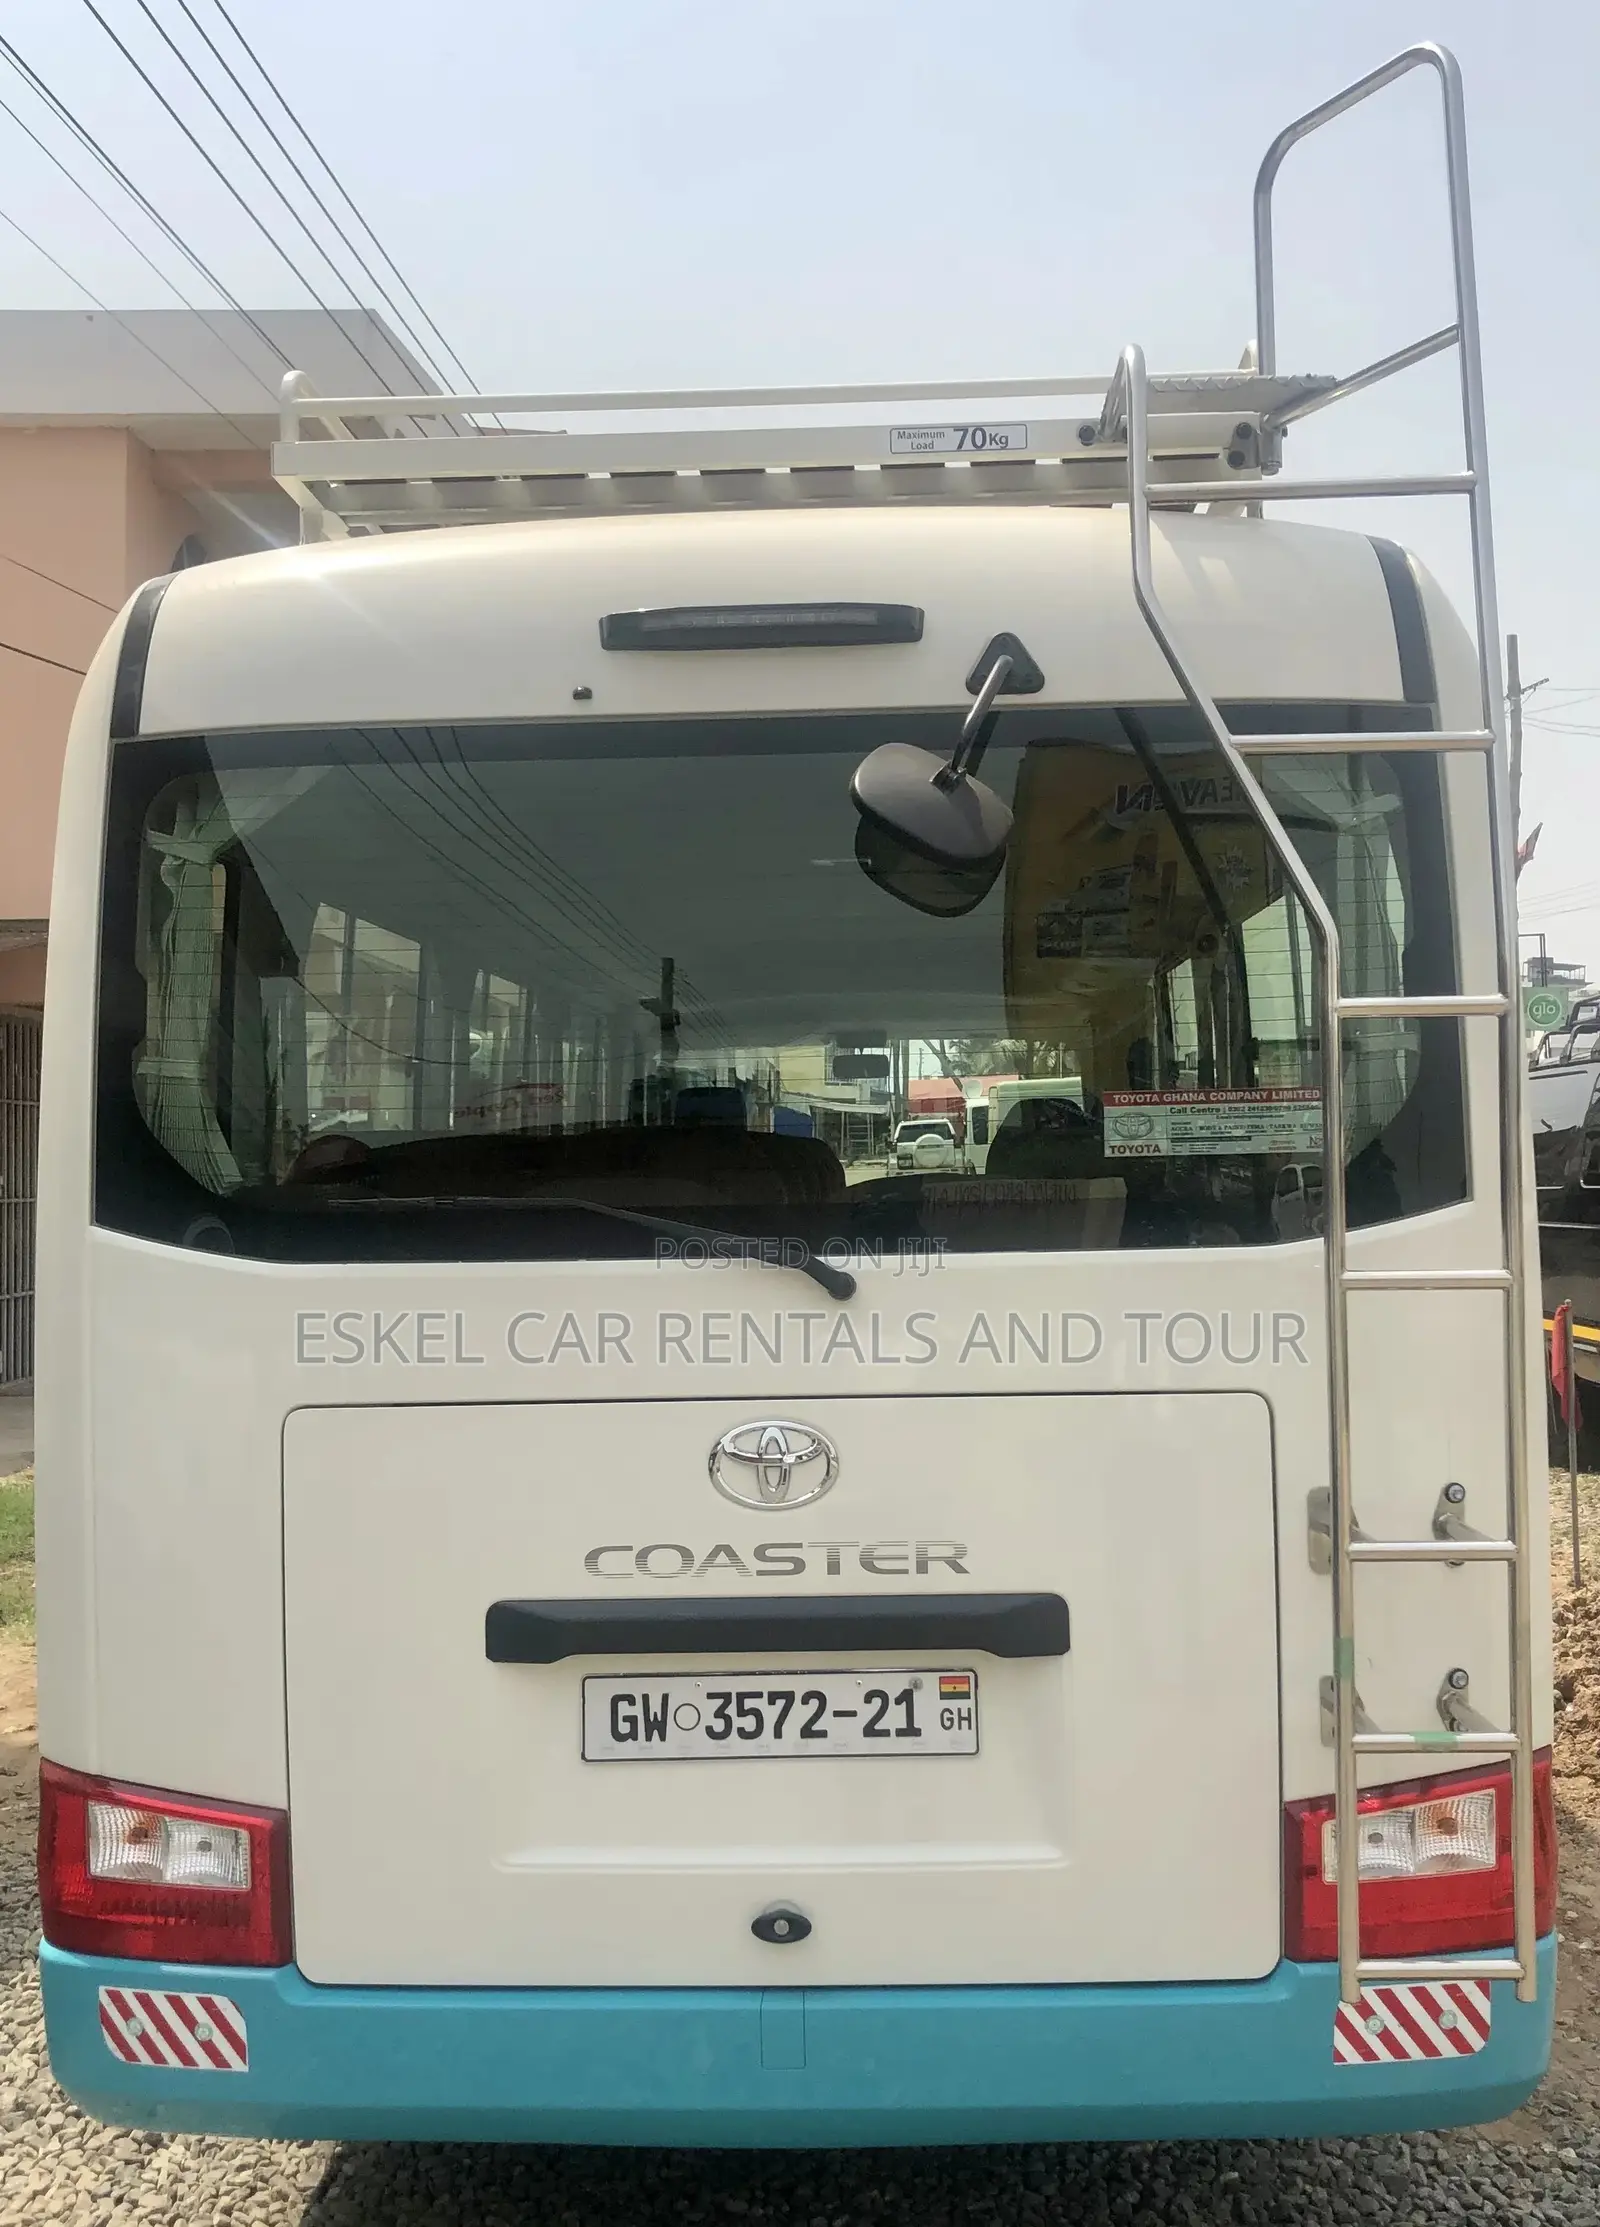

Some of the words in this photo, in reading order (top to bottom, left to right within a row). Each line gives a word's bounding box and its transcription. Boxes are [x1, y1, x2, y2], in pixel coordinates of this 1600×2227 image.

[896, 430, 945, 440] Maximum
[910, 441, 934, 451] Load
[1532, 1001, 1556, 1019] glo
[1113, 1093, 1160, 1103] TOYOTA
[1163, 1092, 1206, 1102] GHANA
[1209, 1090, 1269, 1101] COMPANY
[1271, 1089, 1320, 1100] LIMITED
[1169, 1106, 1188, 1114] Call
[1109, 1143, 1161, 1154] TOYOTA
[584, 1540, 971, 1579] COASTER
[609, 1692, 670, 1743] GW
[704, 1688, 922, 1741] 3572-21
[939, 1707, 972, 1731] GH
